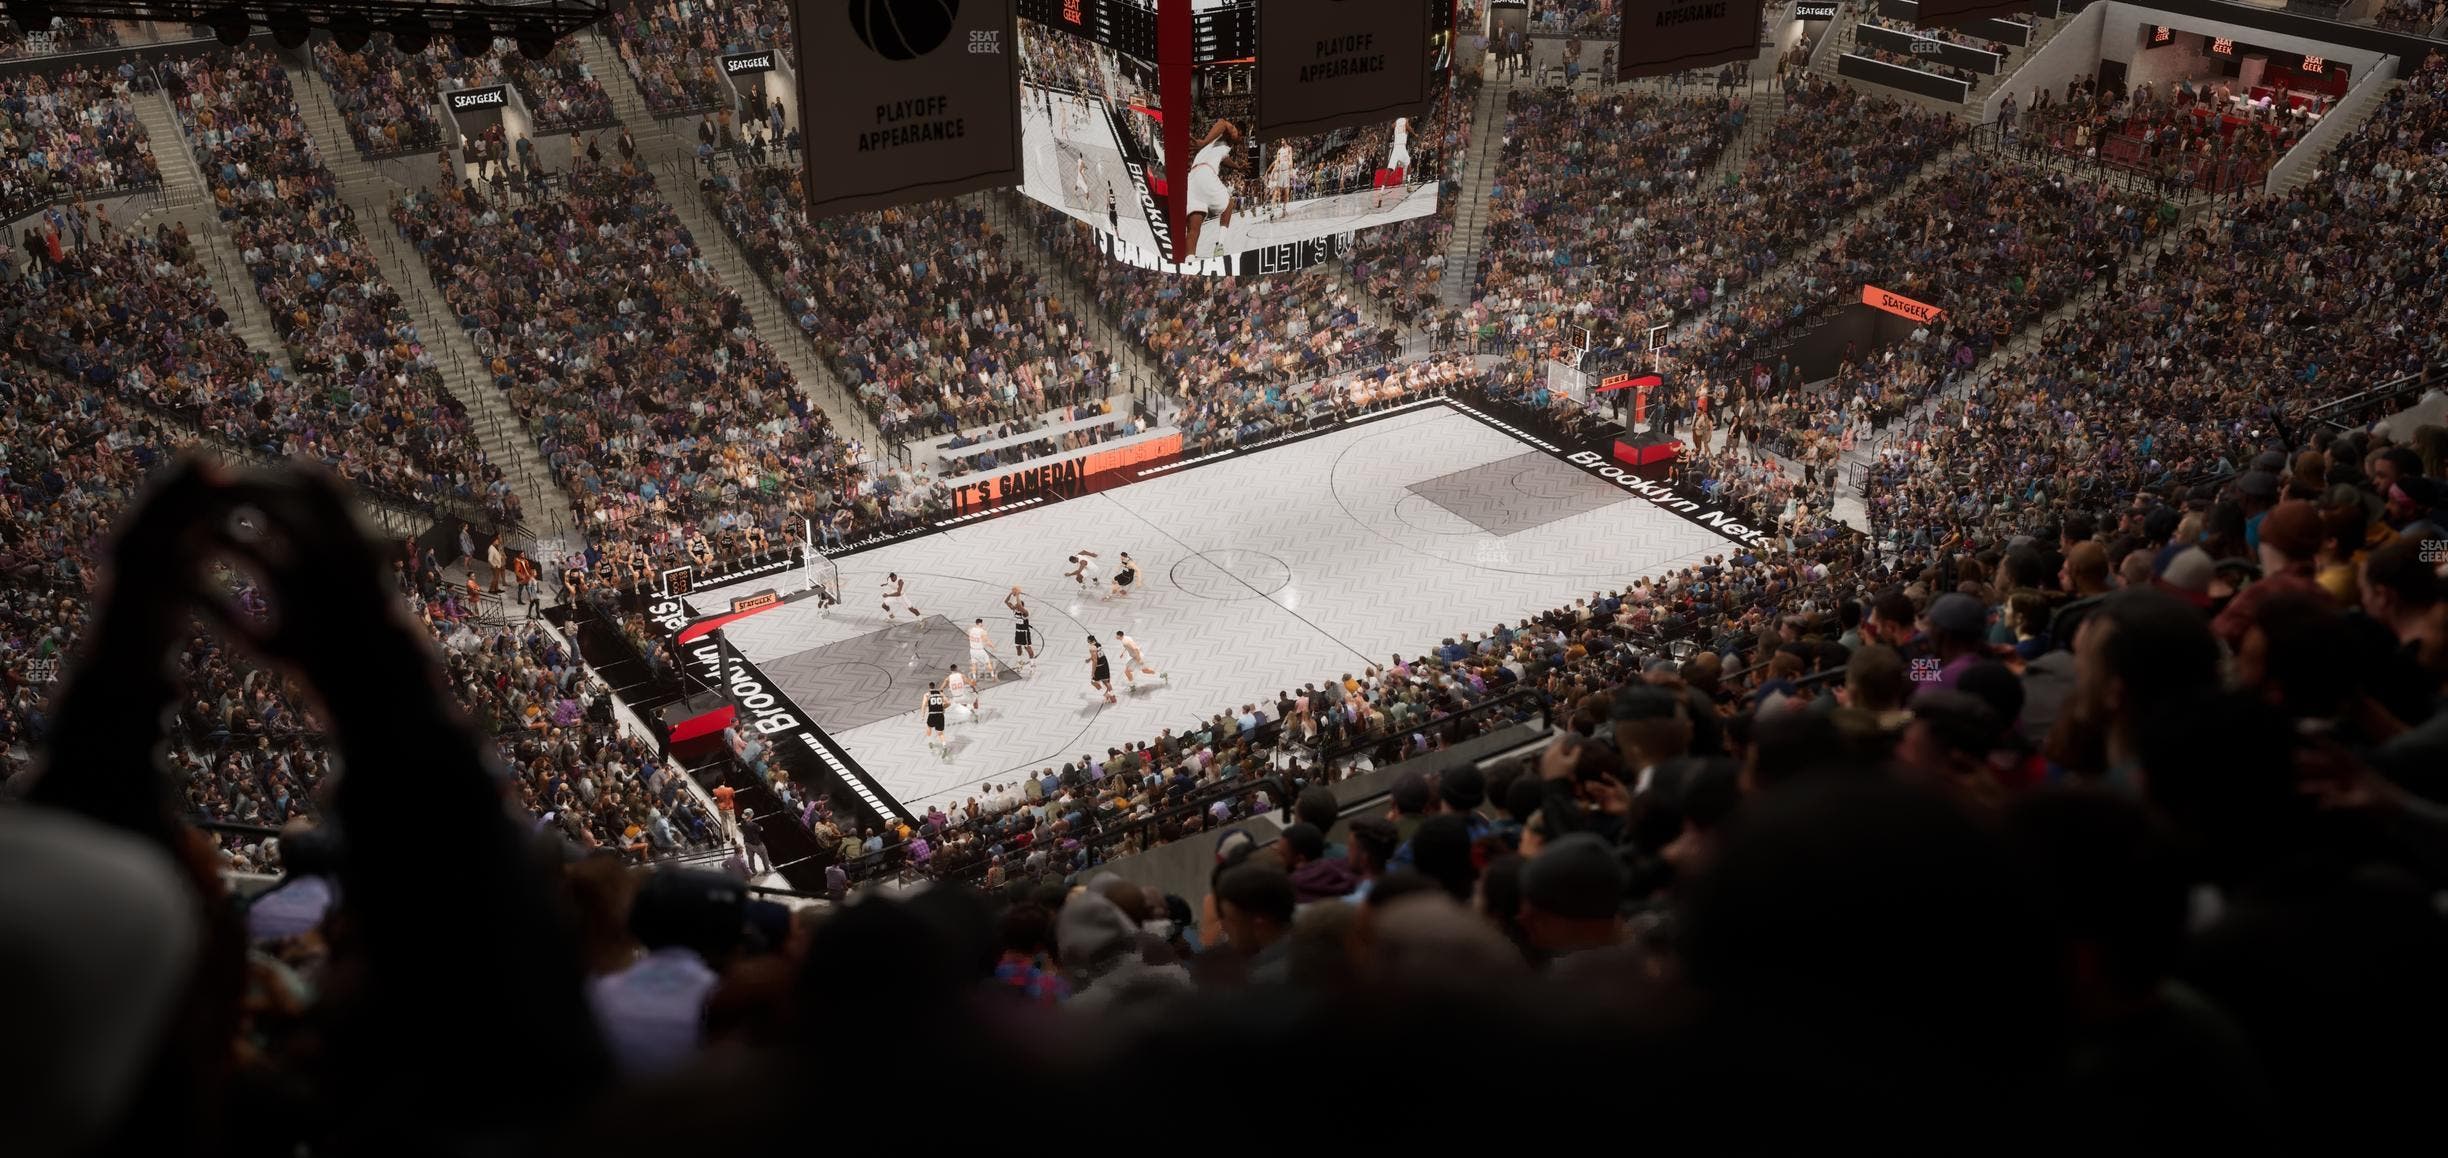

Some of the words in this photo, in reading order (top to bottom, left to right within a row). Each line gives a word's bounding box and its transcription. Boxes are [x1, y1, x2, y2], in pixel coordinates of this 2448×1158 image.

[1063, 8, 1081, 26] GEEK
[1796, 6, 1835, 16] SEATGEEK
[1316, 33, 1373, 58] PLAYOFF
[2213, 44, 2232, 55] GEEK
[728, 56, 770, 71] SEATGEEK
[1299, 54, 1385, 83] APPEARANCE
[2303, 62, 2323, 73] GEEK
[2305, 55, 2325, 65] SEAT
[454, 90, 503, 108] SEATGEEK
[876, 95, 947, 124] PLAYOFF
[858, 118, 964, 152] APPEARANCE
[1882, 294, 1928, 320] SEATGEEK
[951, 480, 991, 507] IT'S
[999, 456, 1087, 496] GAMEDAY
[1566, 450, 1700, 513] Brooklyn
[1696, 510, 1777, 552] Nets
[930, 697, 943, 706] 00
